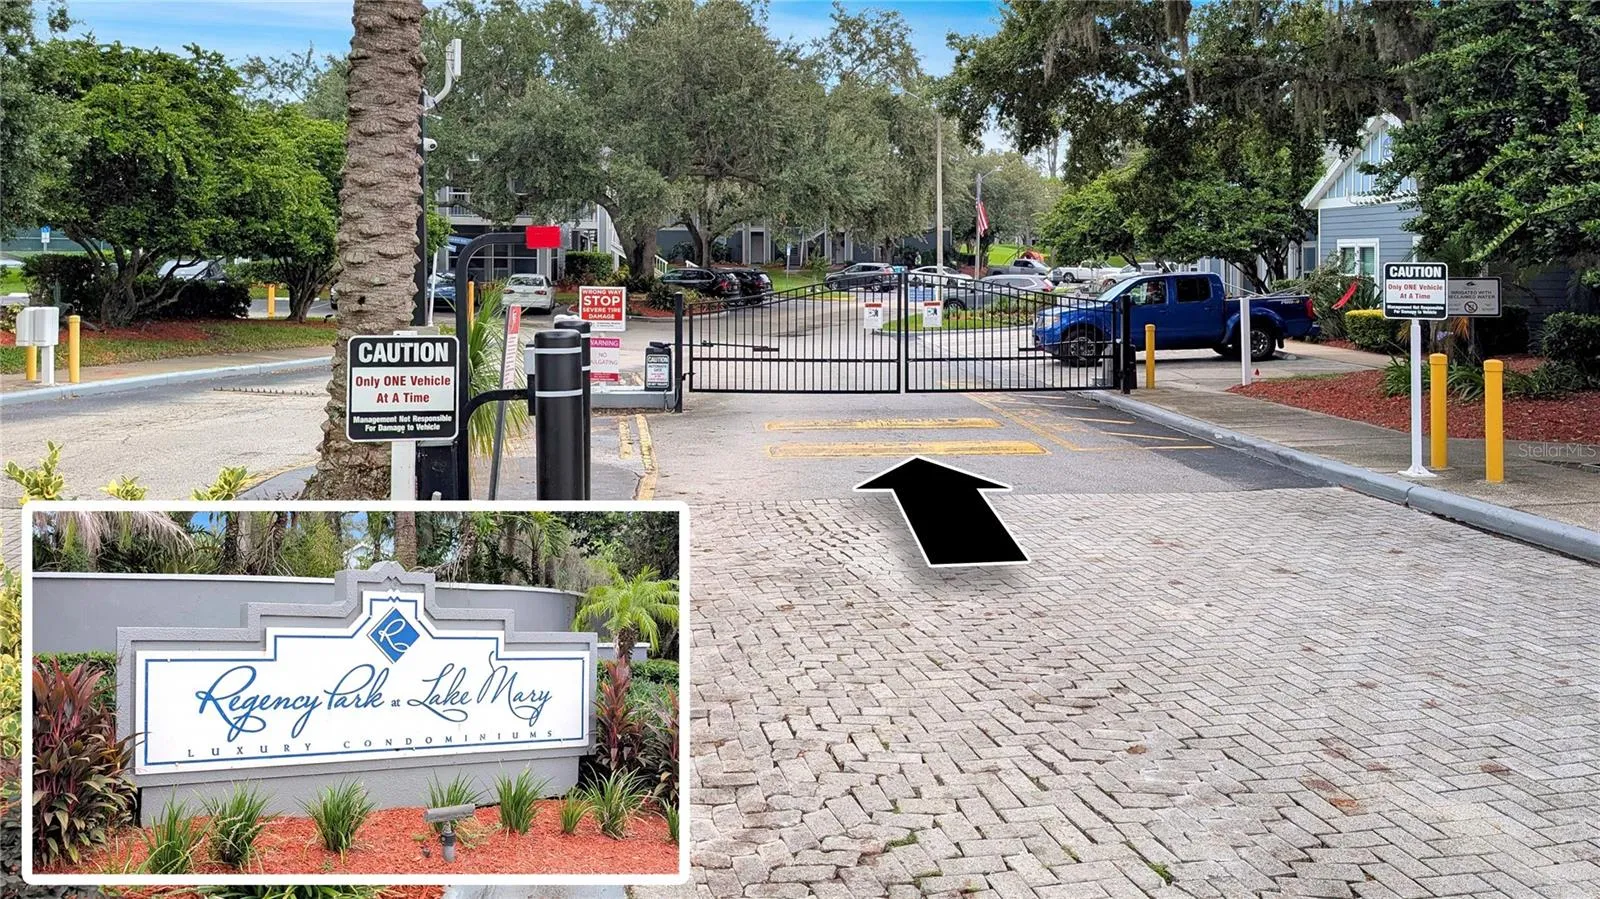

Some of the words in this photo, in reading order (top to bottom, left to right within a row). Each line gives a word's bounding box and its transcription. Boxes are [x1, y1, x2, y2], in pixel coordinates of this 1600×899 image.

[1390, 266, 1442, 278] CAUTION
[583, 295, 620, 306] STOP
[358, 342, 448, 363] CAUTION
[355, 376, 380, 389] Only
[384, 376, 406, 386] ONE
[410, 376, 451, 386] Vehicle
[376, 393, 388, 403] At
[392, 393, 399, 403] A
[403, 393, 430, 403] Time
[353, 416, 397, 424] Management
[413, 415, 452, 424] Responsible
[378, 424, 405, 433] Damage
[195, 665, 323, 742] Regency
[323, 664, 389, 710] Park
[391, 699, 400, 707] at
[407, 663, 472, 722] Lake
[476, 650, 552, 727] Mary
[188, 742, 312, 758] LUXURY
[343, 730, 552, 748] CONDOMINIUMS
